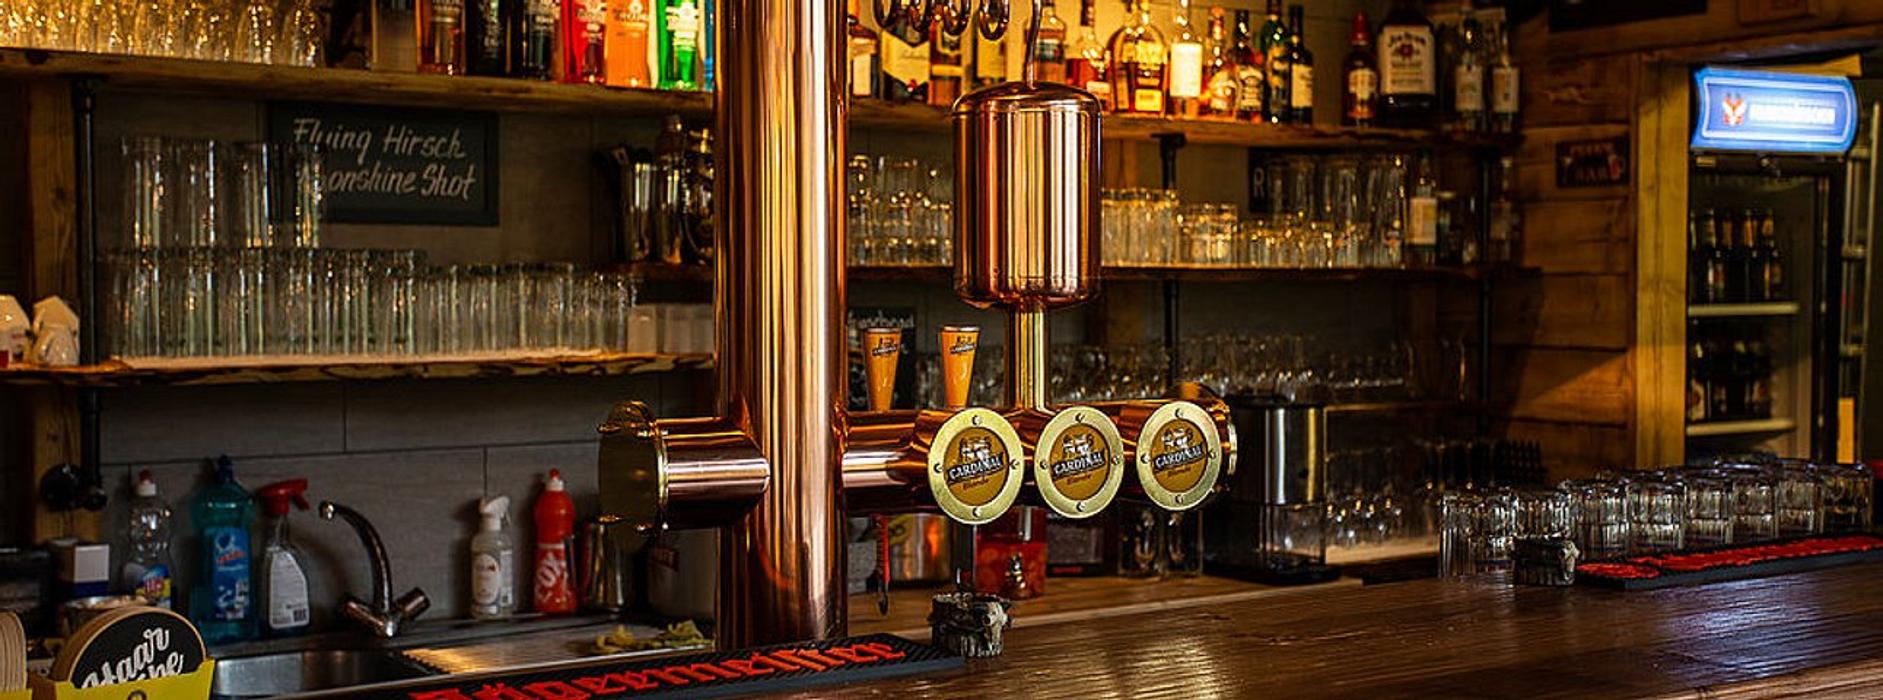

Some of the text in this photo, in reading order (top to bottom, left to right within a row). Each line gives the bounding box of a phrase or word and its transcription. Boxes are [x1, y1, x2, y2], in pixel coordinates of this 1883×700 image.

[382, 125, 466, 159] Hirsch
[421, 163, 475, 199] Shot
[949, 455, 1002, 480] CARDINAL
[1054, 452, 1104, 474] CARDINAL
[1155, 445, 1202, 468] CARDINAL
